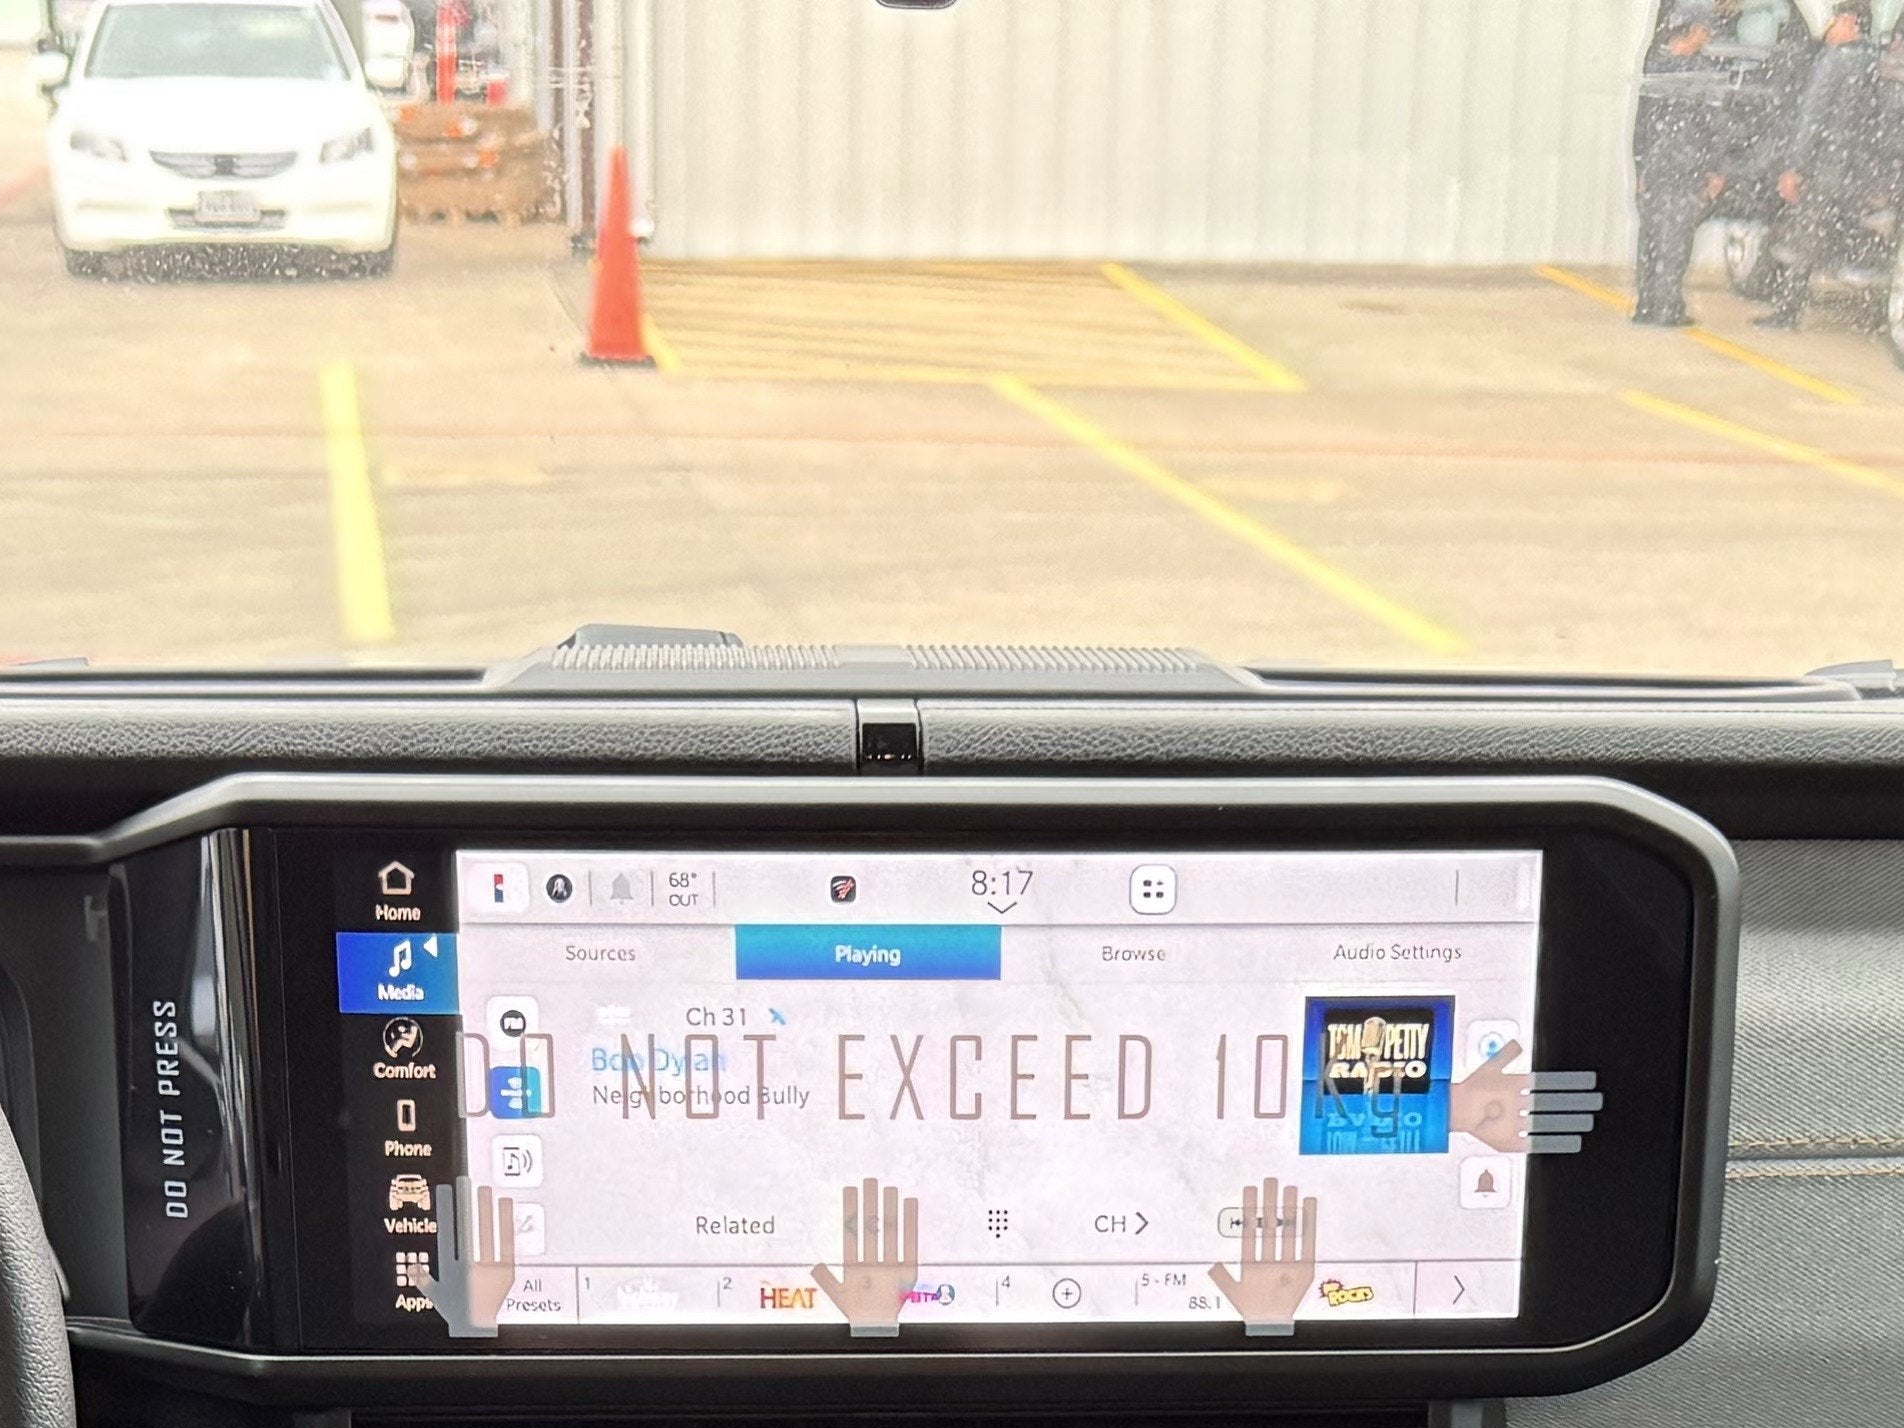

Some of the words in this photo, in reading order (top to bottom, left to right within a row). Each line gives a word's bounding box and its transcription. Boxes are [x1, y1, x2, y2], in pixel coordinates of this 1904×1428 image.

[971, 869, 1034, 898] 8:17
[668, 894, 699, 906] OUT
[375, 905, 421, 922] Home
[565, 944, 636, 962] Sources
[834, 945, 902, 967] Playing
[1101, 944, 1166, 962] Browse
[1332, 943, 1386, 961] Audio
[1390, 943, 1463, 964] Settings
[377, 984, 425, 1001] Media
[686, 1007, 717, 1026] Ch
[722, 1008, 747, 1026] 31
[152, 1000, 182, 1097] PRESS
[1385, 1022, 1430, 1060] PETTY
[373, 1062, 437, 1080] Comfort
[655, 1047, 726, 1077] Dyan
[456, 1031, 556, 1120] DO
[620, 1033, 777, 1120] NOT
[838, 1033, 1153, 1121] EXCEED
[159, 1109, 186, 1167] NOT
[384, 1141, 432, 1158] Phone
[164, 1180, 189, 1219] DO
[384, 1218, 437, 1235] Vehicle
[695, 1216, 776, 1234] Related
[1095, 1214, 1127, 1233] CH
[522, 1279, 542, 1292] All
[506, 1298, 562, 1312] Presets
[760, 1287, 818, 1309] HEAT
